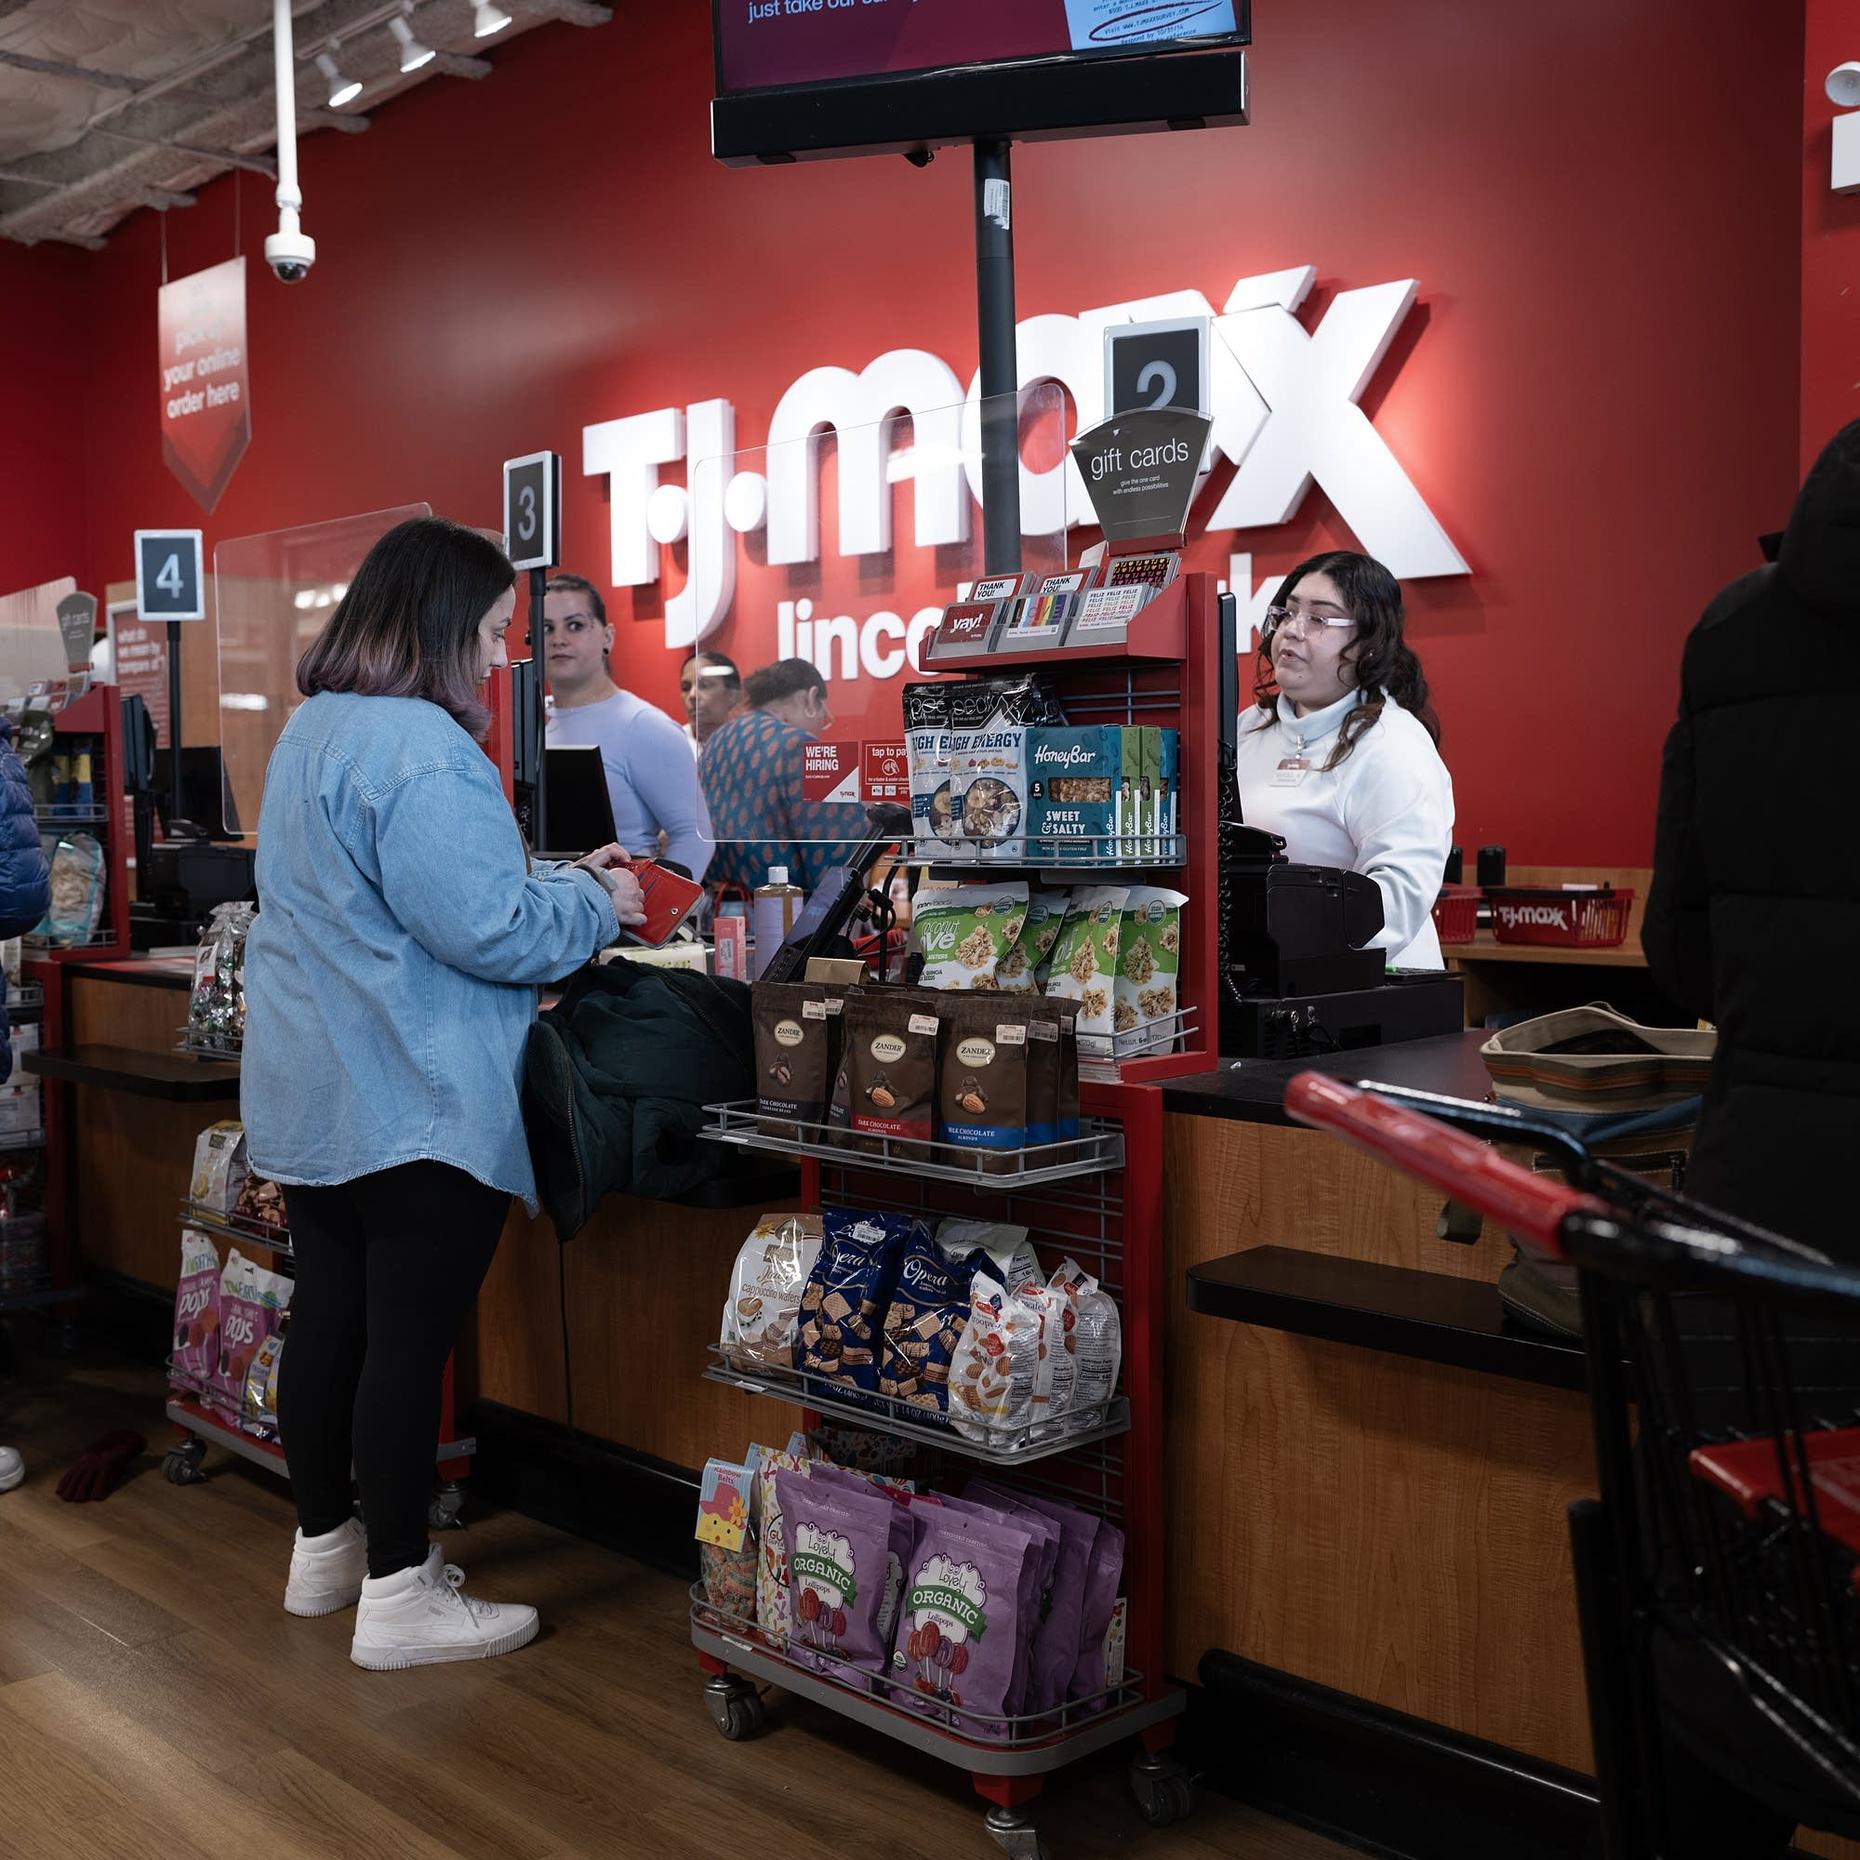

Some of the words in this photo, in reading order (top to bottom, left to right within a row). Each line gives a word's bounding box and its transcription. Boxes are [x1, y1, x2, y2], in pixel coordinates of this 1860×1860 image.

[748, 1, 781, 24] just
[784, 0, 824, 15] take
[163, 360, 195, 393] your
[196, 347, 241, 376] online
[1136, 360, 1178, 411] 2
[166, 389, 206, 420] order
[206, 381, 240, 408] here
[1090, 447, 1123, 480] gift
[1130, 437, 1189, 469] cards
[1120, 479, 1131, 487] give
[1149, 475, 1161, 483] card
[1124, 486, 1141, 494] endless
[1141, 482, 1169, 491] possibilities
[518, 485, 537, 542] 3
[155, 553, 184, 599] 4
[1045, 576, 1072, 586] THANK
[977, 590, 996, 598] YOU!
[979, 581, 1005, 591] THANK
[950, 613, 984, 634] yay!
[972, 732, 1023, 750] ENERGY
[805, 745, 837, 758] WE'RE
[872, 748, 885, 758] tap
[886, 747, 895, 756] to
[1034, 744, 1096, 769] HoneyBar
[805, 759, 839, 771] HIRING
[1034, 783, 1040, 792] 5
[1046, 811, 1081, 822] SWEET
[1041, 822, 1053, 834] &
[1053, 824, 1086, 834] SALTY
[769, 1100, 798, 1110] CHOCOLATE
[869, 1120, 901, 1130] CHOCOLATE
[959, 1128, 995, 1137] CHOCOLATE
[903, 1258, 950, 1287] Opera
[177, 1287, 212, 1320] pops
[779, 1290, 801, 1303] wafers
[713, 1466, 742, 1478] Rainbow
[717, 1474, 735, 1484] Belts
[807, 1533, 837, 1561] Lovely
[794, 1557, 851, 1591] ORGANIC
[939, 1568, 968, 1595] Lovely
[804, 1578, 831, 1594] Lollipops
[912, 1591, 978, 1625] ORGANIC
[927, 1610, 955, 1628] Lollipops
